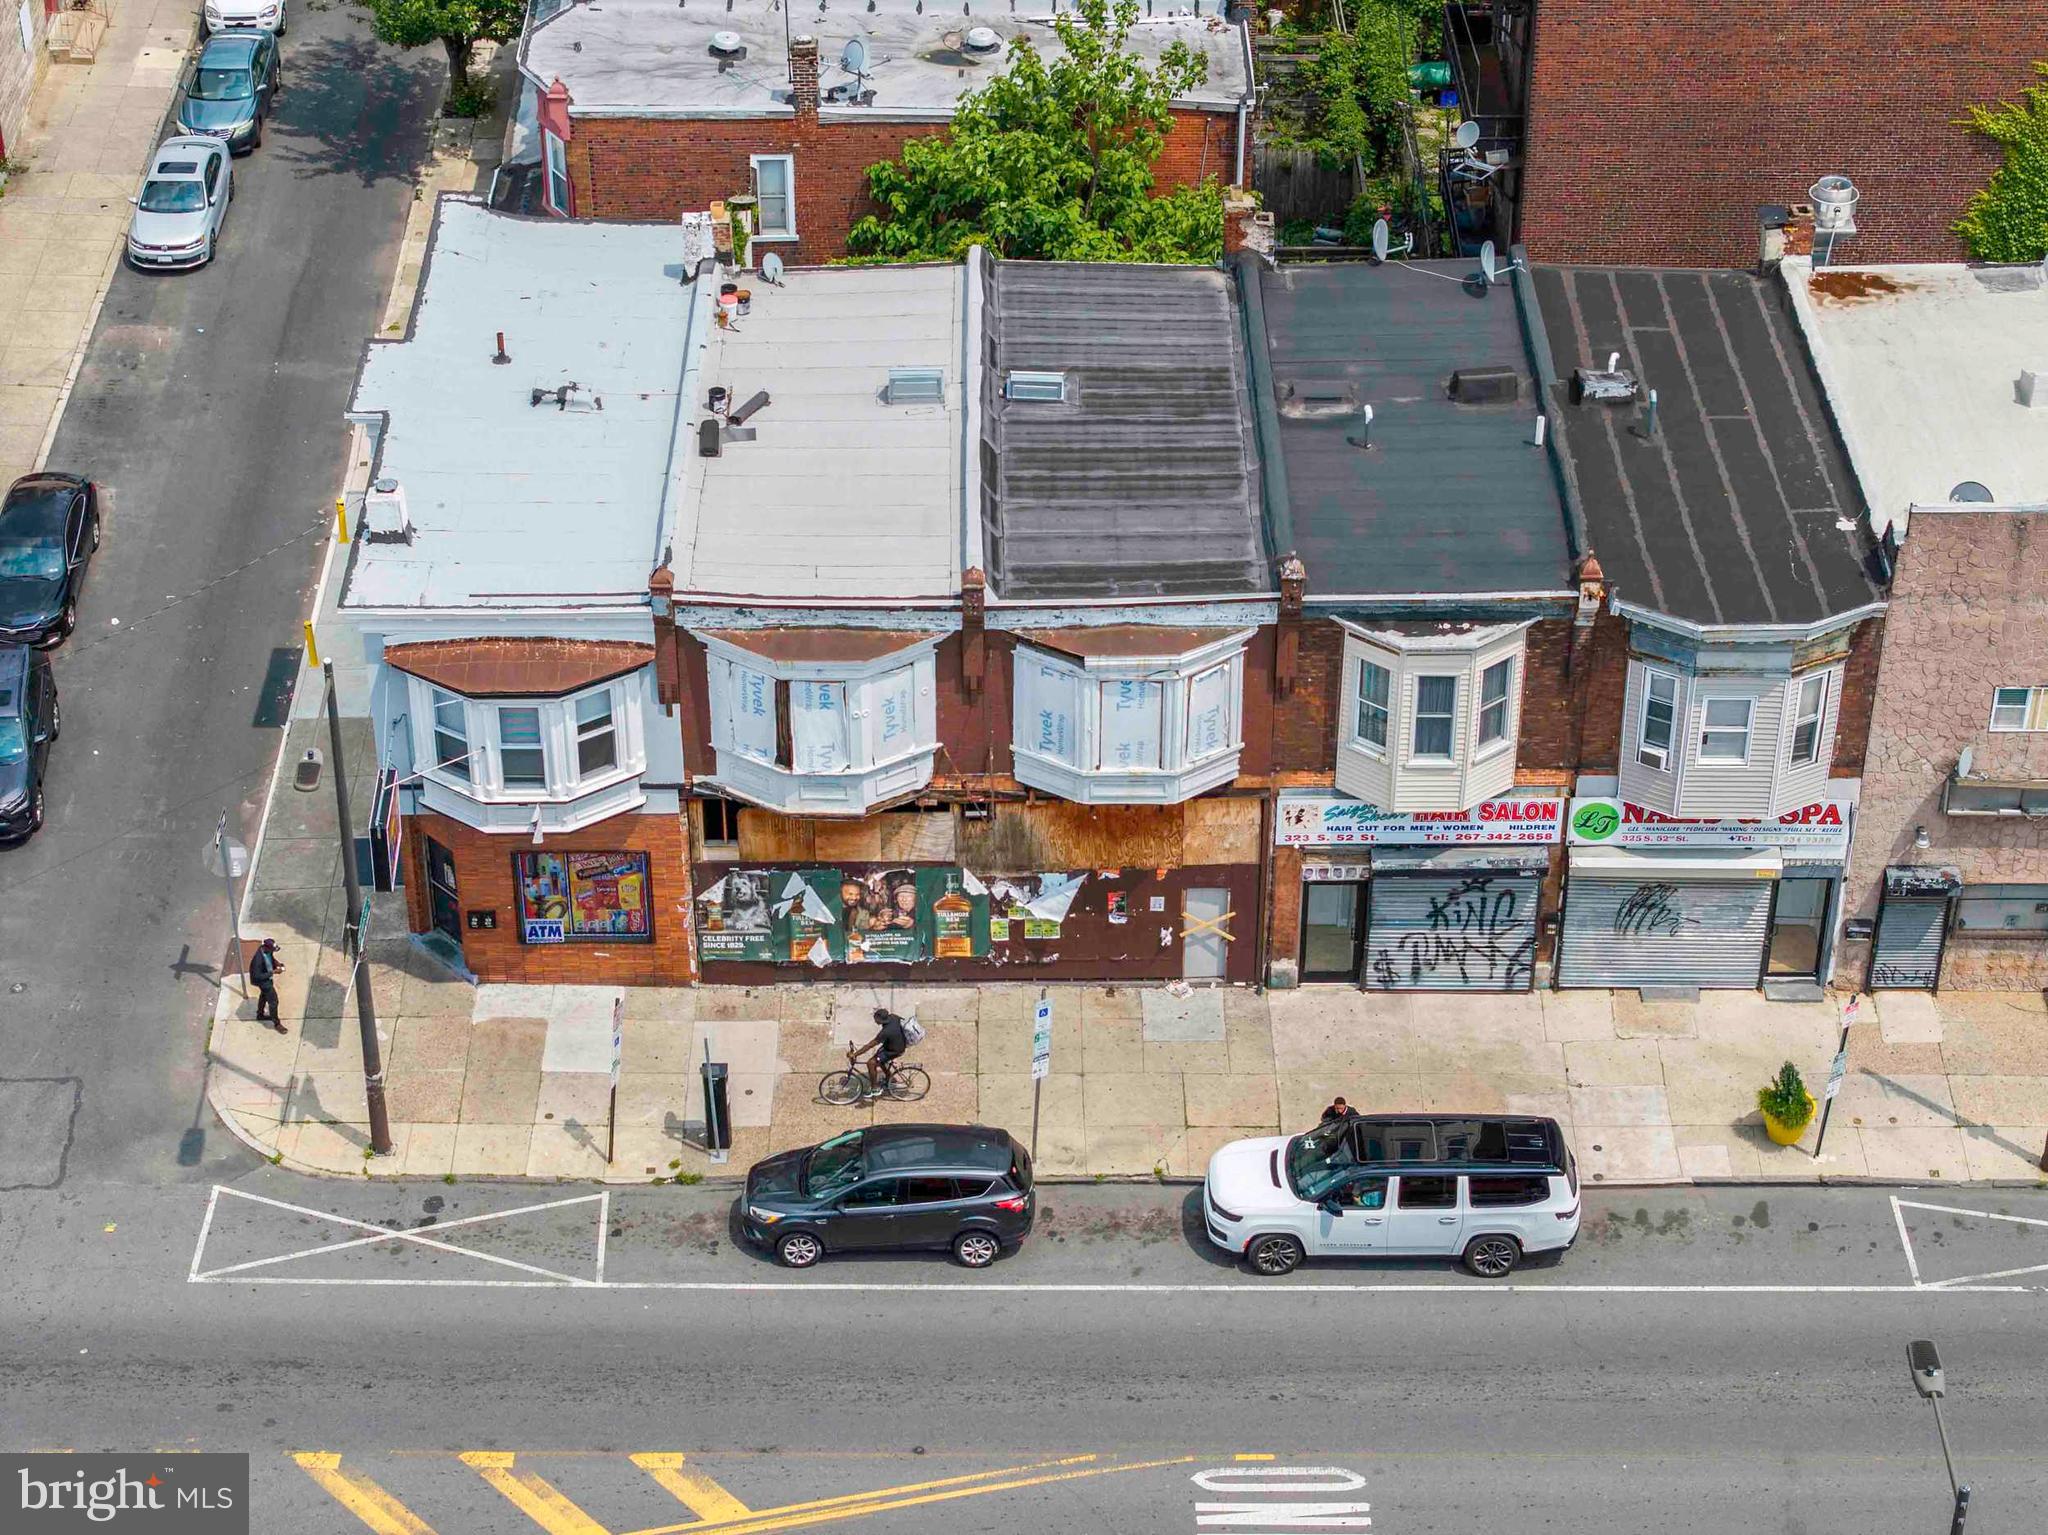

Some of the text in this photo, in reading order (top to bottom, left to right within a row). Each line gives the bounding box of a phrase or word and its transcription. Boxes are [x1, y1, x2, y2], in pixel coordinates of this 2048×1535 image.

[750, 675, 766, 717] Tyvek
[882, 697, 897, 742] Tyvek
[1040, 710, 1053, 752] Tyvek
[1058, 713, 1066, 755] HomeWrap
[1204, 704, 1219, 750] Tyvek
[1478, 801, 1557, 822] SALON
[1778, 803, 1843, 825] SPA
[1424, 833, 1449, 841] Tel:
[528, 925, 562, 938] ATM
